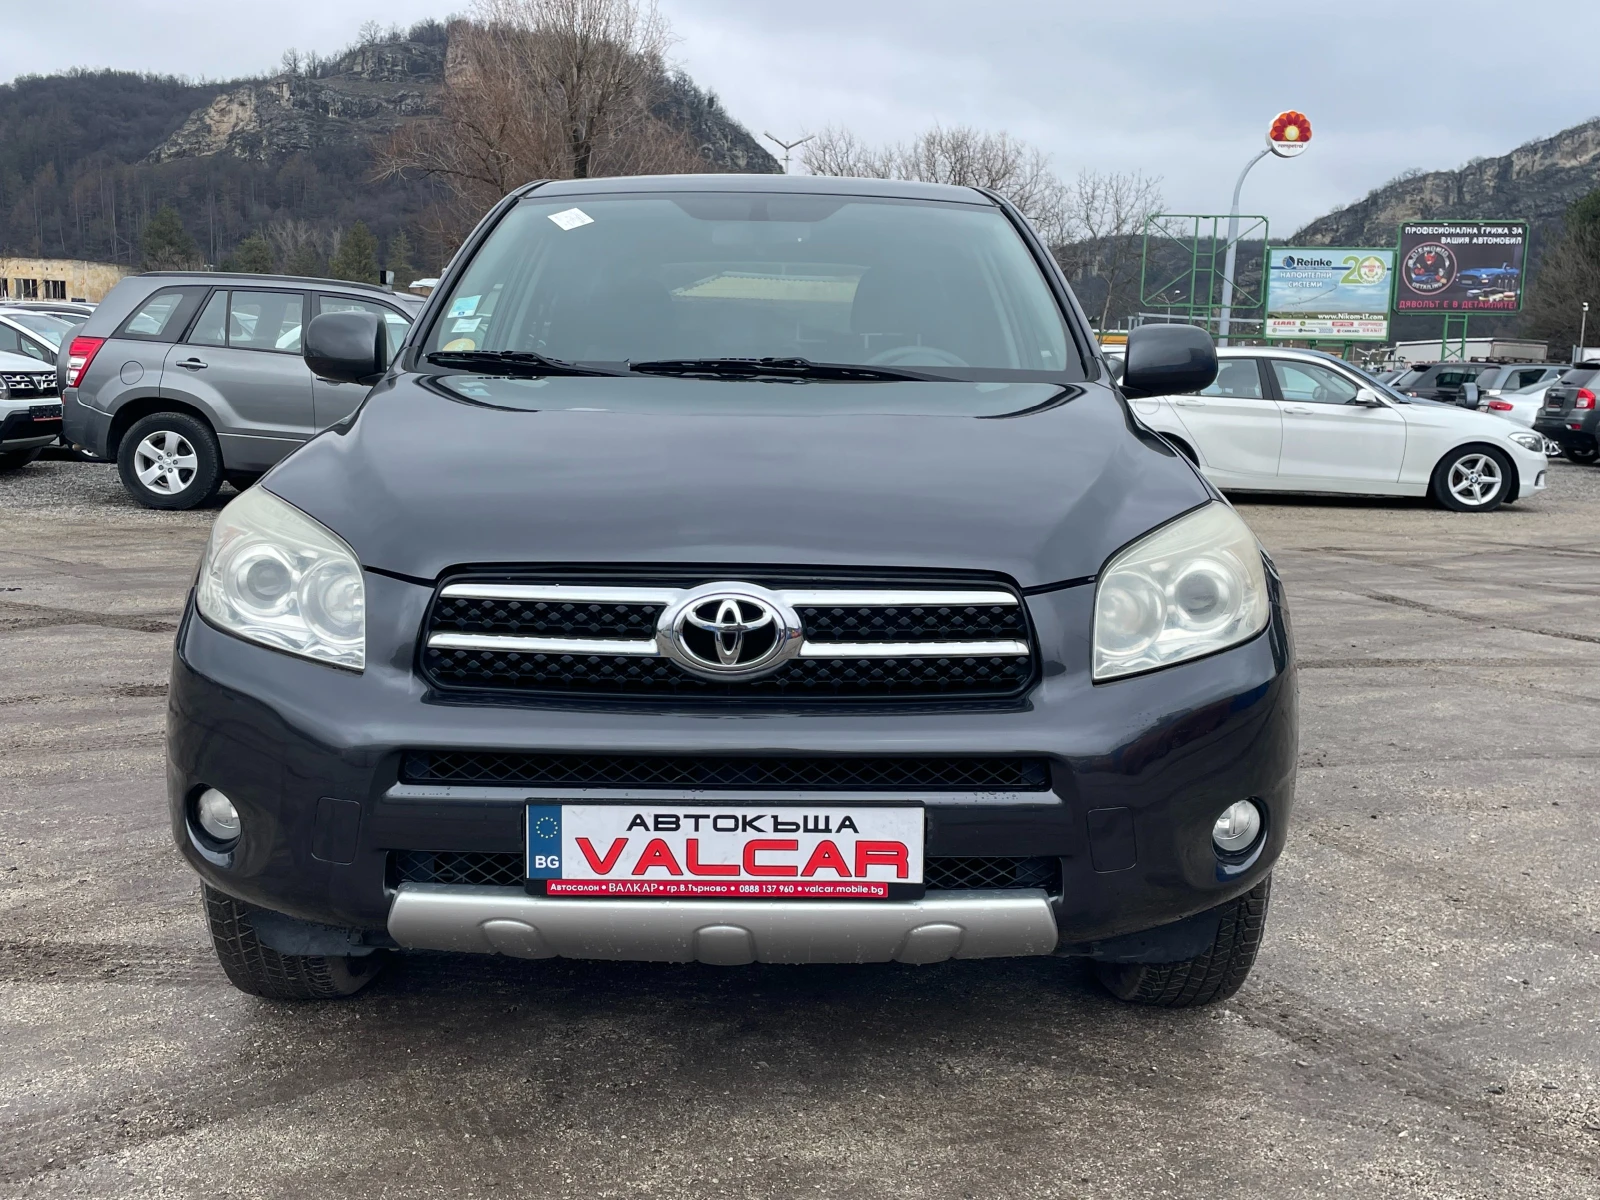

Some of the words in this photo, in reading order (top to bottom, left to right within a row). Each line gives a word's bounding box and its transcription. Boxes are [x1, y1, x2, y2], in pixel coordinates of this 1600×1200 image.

[1405, 227, 1478, 235] ПРОФЕСИОНАЛНА
[1481, 227, 1509, 235] ГРИЖА
[1511, 227, 1523, 235] ЗА
[1440, 237, 1470, 245] ВАШИЯ
[1472, 237, 1522, 245] АВТОМОБИЛ
[1296, 258, 1333, 267] Reinke
[1340, 255, 1387, 285] 20
[1398, 300, 1440, 309] ДЯВОЛЪТ
[1317, 313, 1384, 321] www.Nikom-LT.com
[626, 814, 860, 834] АВТОКЪЩА
[535, 855, 560, 869] BG
[575, 837, 909, 879] VALCAR
[550, 883, 600, 892] Автосалон
[608, 882, 658, 893] ВАЛКАР
[666, 884, 728, 893] гр.В.Търново
[739, 885, 760, 893] 0888
[762, 885, 777, 893] 137
[779, 885, 795, 893] 960
[804, 885, 884, 895] valcar.mobile.bg
